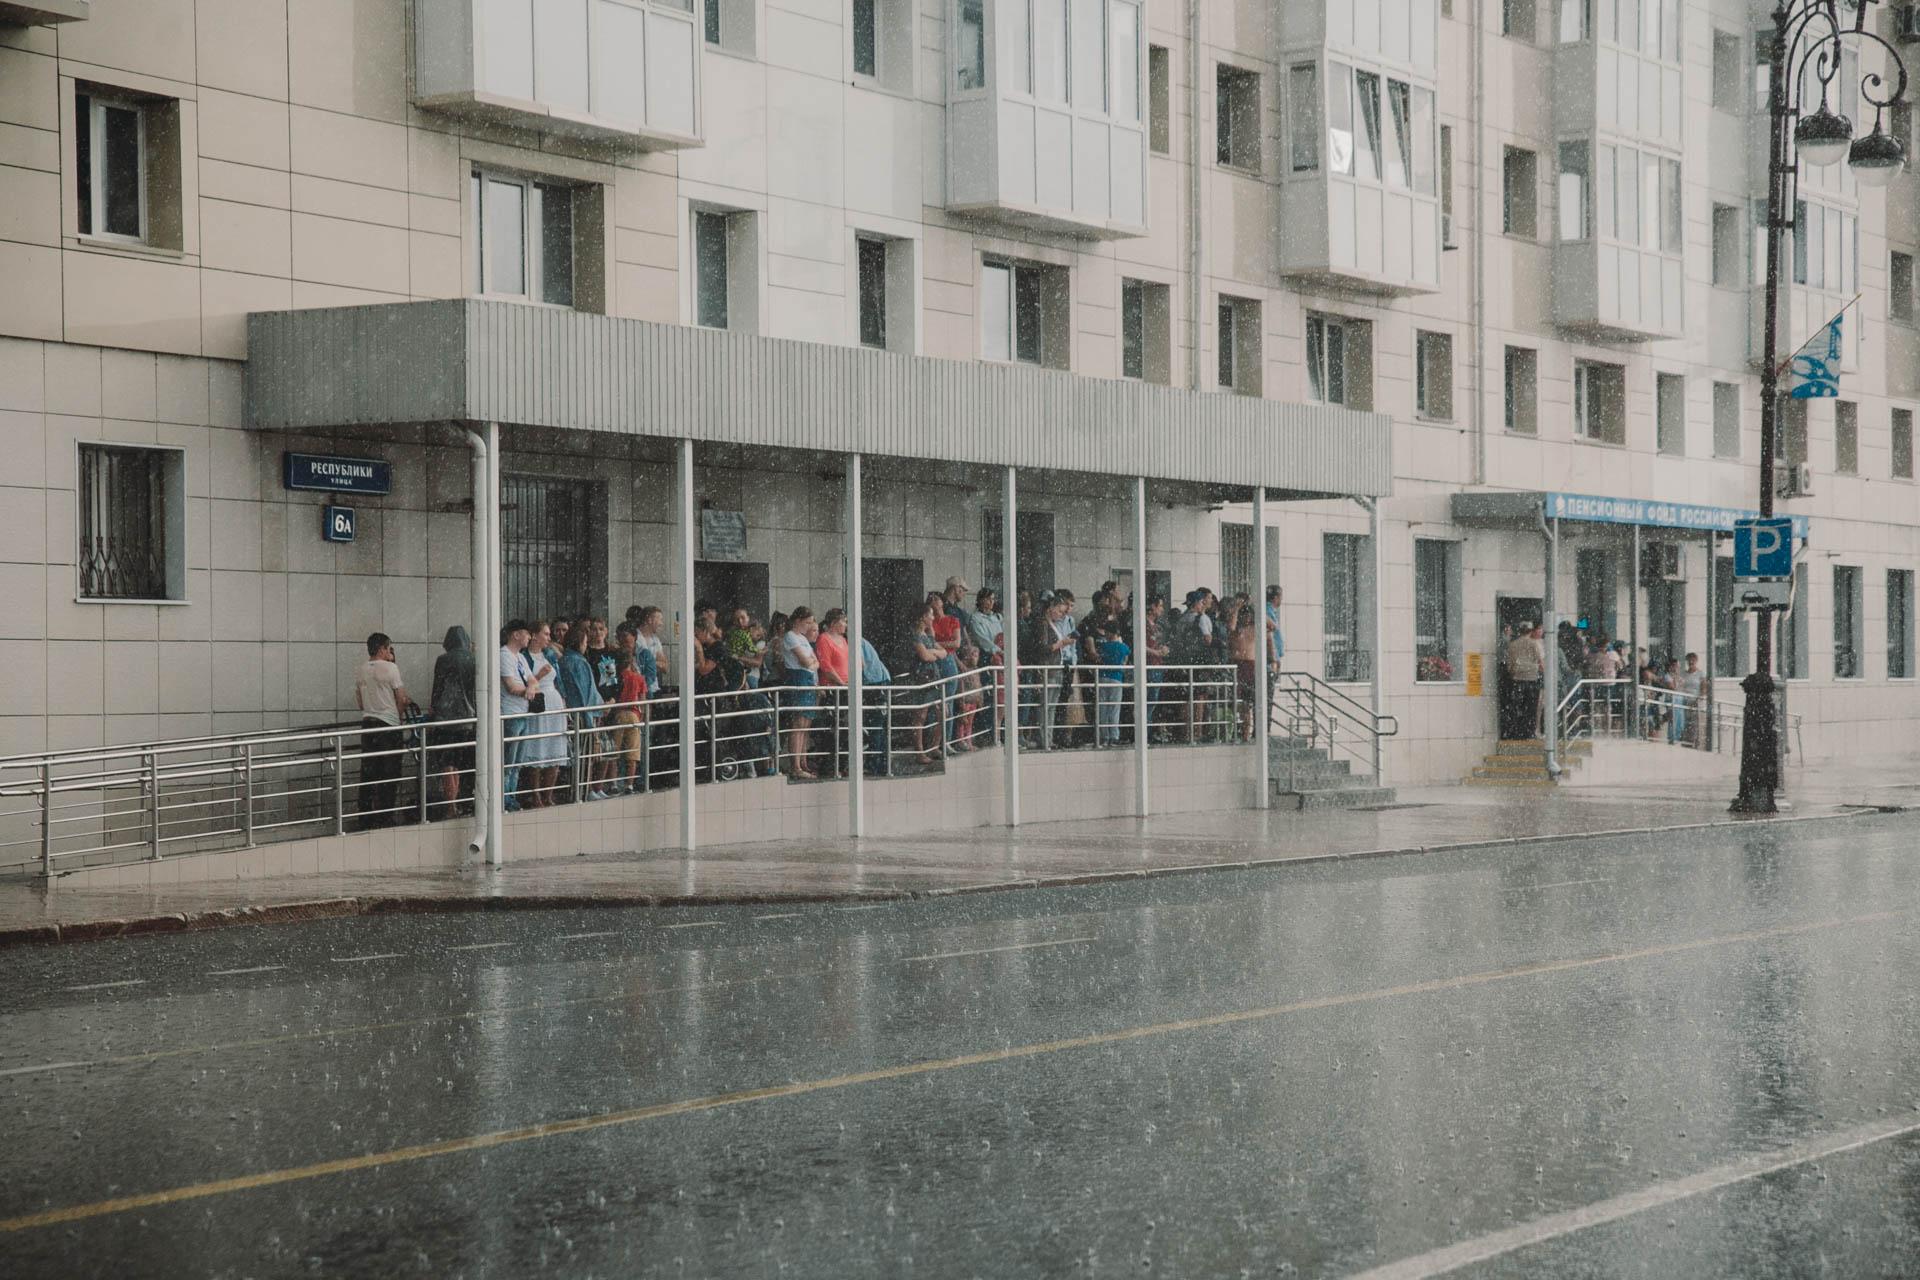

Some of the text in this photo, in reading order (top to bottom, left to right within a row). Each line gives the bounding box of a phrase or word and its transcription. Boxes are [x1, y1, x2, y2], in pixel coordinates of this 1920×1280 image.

[311, 462, 373, 478] РЕСПУБЛИКИ
[1568, 498, 1643, 519] ПЕНСИОННЫЙ
[1648, 505, 1676, 524] ФОНД
[335, 514, 351, 533] 6А
[1750, 526, 1781, 572] P
